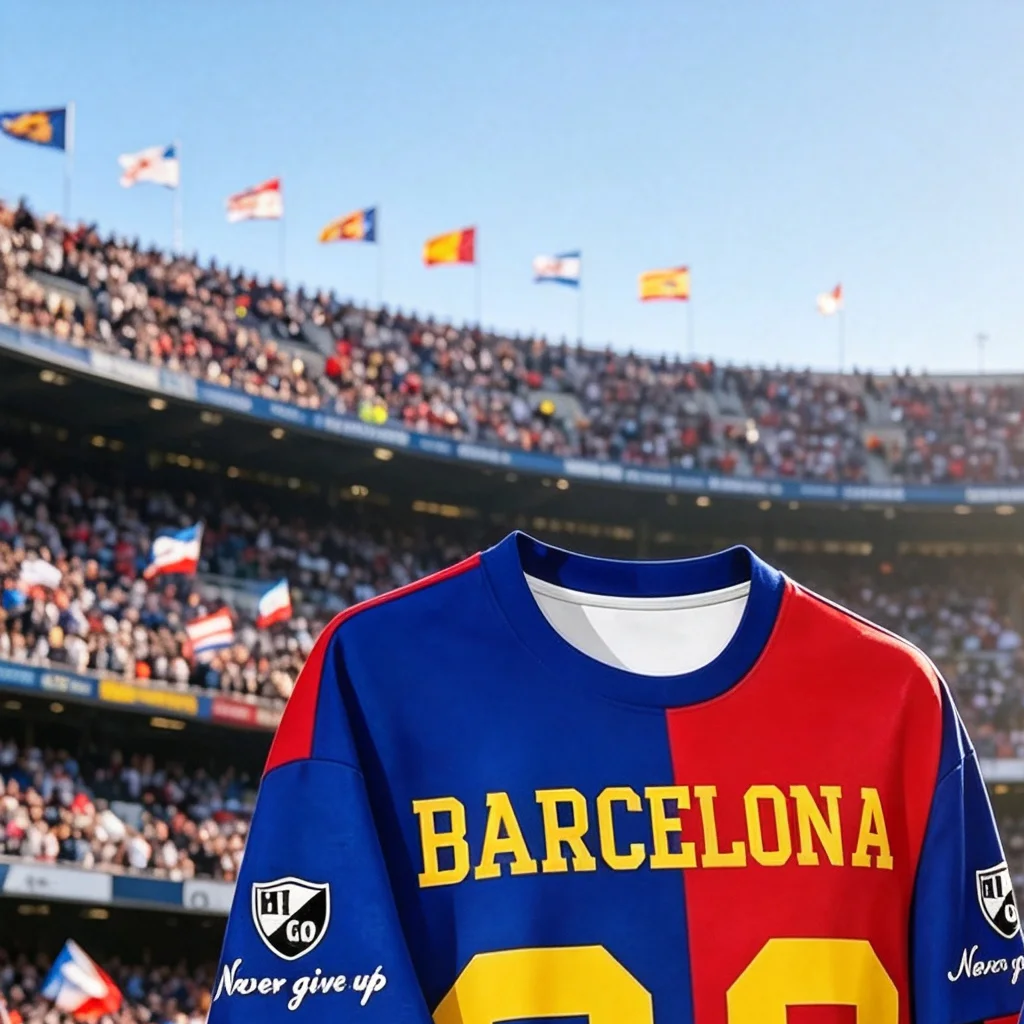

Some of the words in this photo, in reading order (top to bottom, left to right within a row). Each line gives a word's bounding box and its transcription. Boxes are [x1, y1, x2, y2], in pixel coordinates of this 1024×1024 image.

[412, 784, 895, 889] BARCELONA
[286, 919, 317, 943] GO
[287, 967, 347, 1011] give
[352, 965, 388, 1007] up
